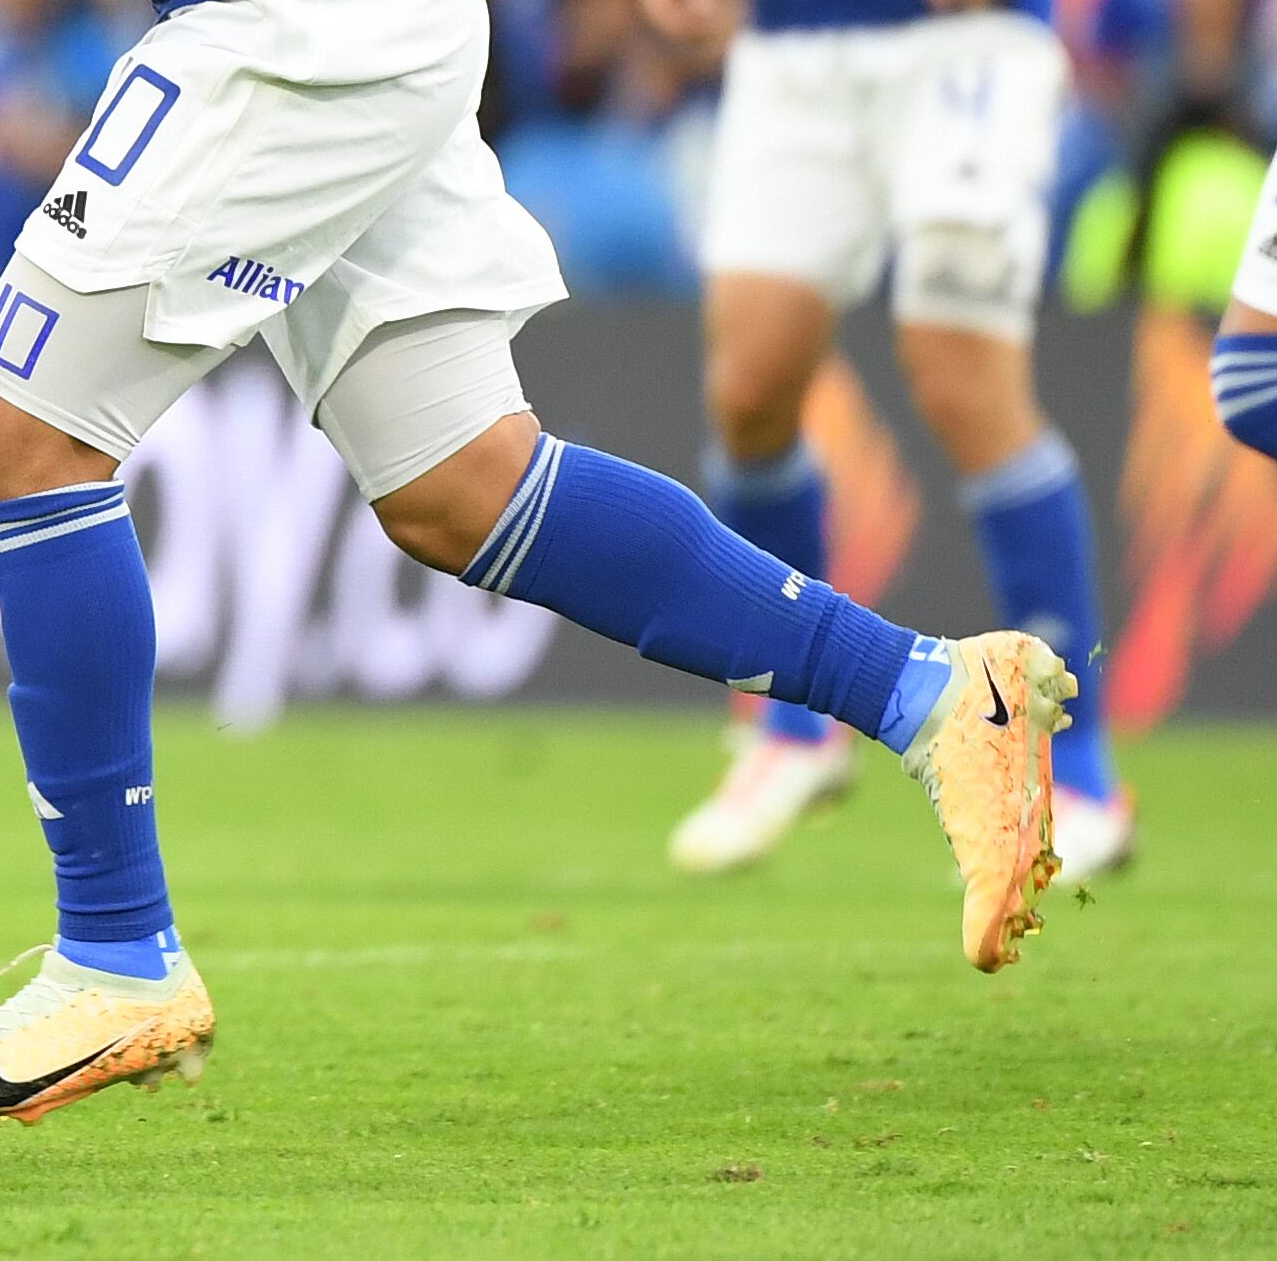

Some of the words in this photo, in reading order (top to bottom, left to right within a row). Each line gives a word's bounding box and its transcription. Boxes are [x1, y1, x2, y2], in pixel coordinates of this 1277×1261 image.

[74, 55, 182, 187] 0
[43, 202, 88, 240] adidas
[206, 255, 305, 306] Allian
